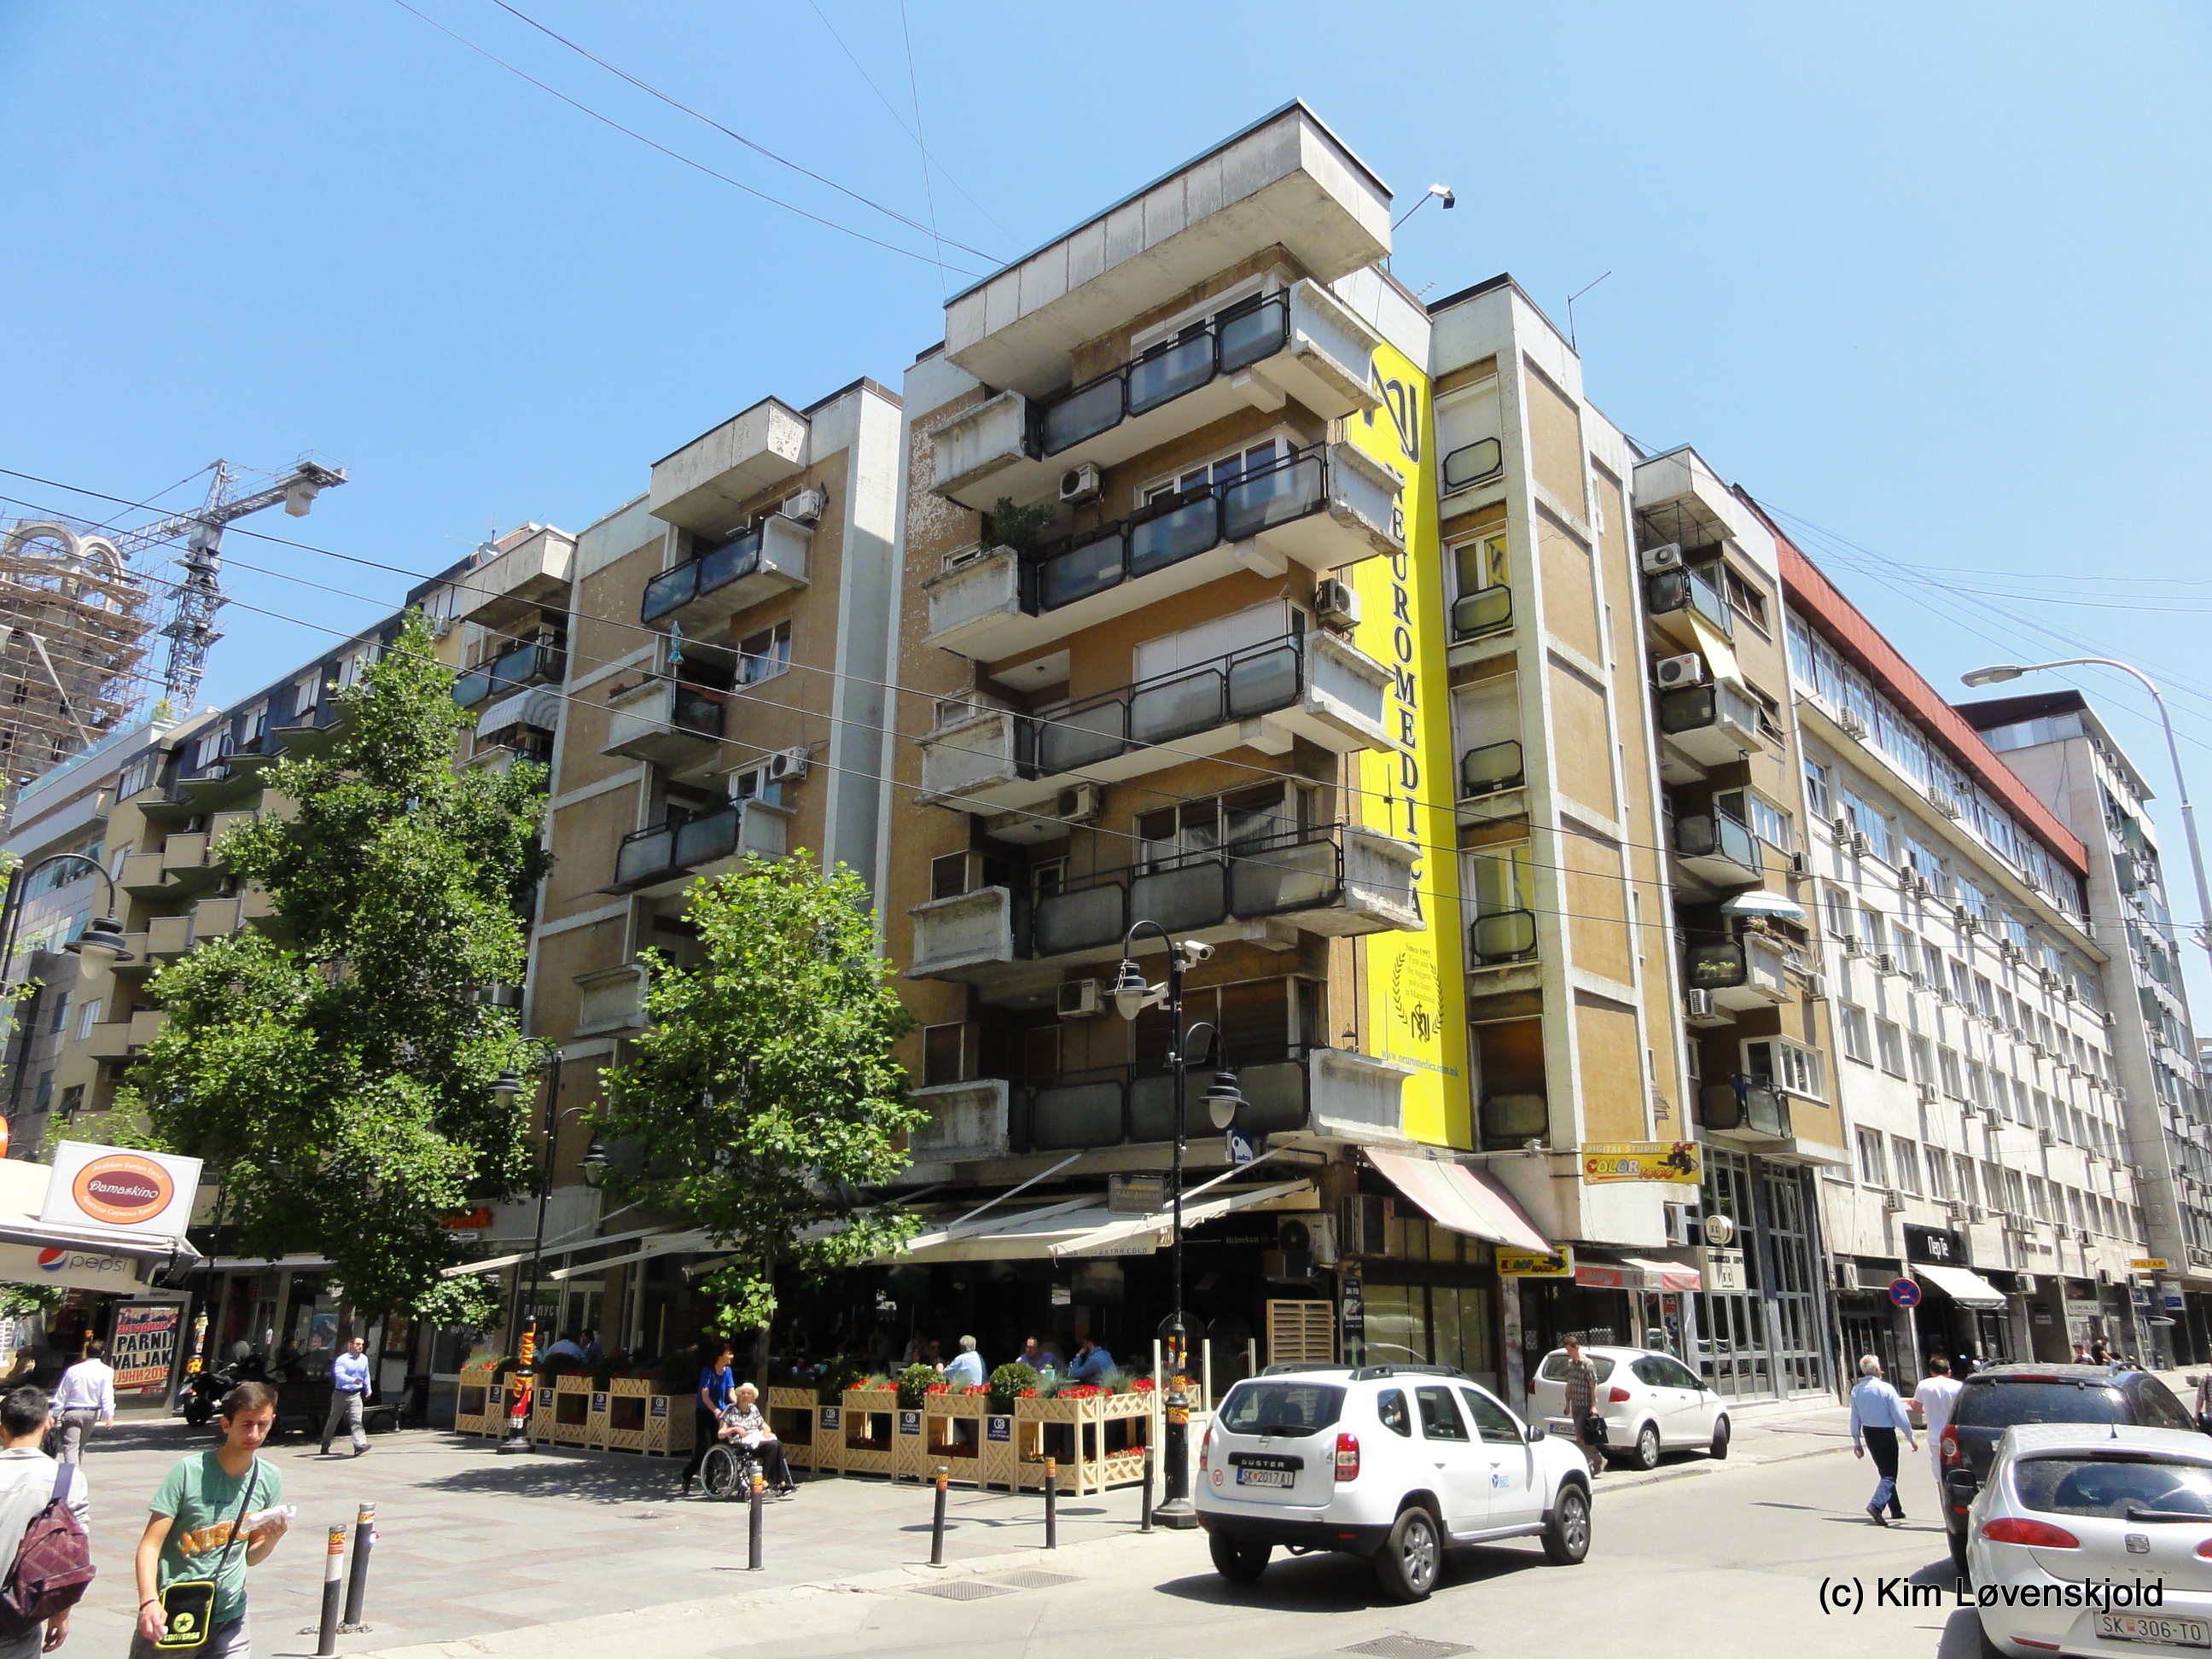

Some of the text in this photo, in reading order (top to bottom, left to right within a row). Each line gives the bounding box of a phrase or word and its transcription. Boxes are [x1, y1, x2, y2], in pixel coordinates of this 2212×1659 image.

[1406, 942, 1430, 958] Since 1992
[1382, 1051, 1459, 1077] www.neuromedica.com.mk
[1586, 1144, 1621, 1154] DIGITAL
[93, 1162, 165, 1180] Arabian Syrian Food
[1586, 1159, 1639, 1174] COLOR
[1639, 1167, 1675, 1179] 1000
[89, 1180, 160, 1199] Damaskino
[1225, 1235, 1259, 1244] Heineken
[69, 1255, 127, 1272] pepsi
[132, 1321, 168, 1333] ГОДИНИ
[117, 1332, 168, 1353] PARNI
[112, 1349, 171, 1371] VALJAK
[116, 1366, 169, 1383] ЈУНИ 2015
[1241, 1459, 1284, 1468] DUSTER
[1243, 1470, 1252, 1482] SK
[1258, 1472, 1278, 1484] 2017
[2103, 1616, 2124, 1634] SK
[163, 1631, 201, 1642] CONVERSE
